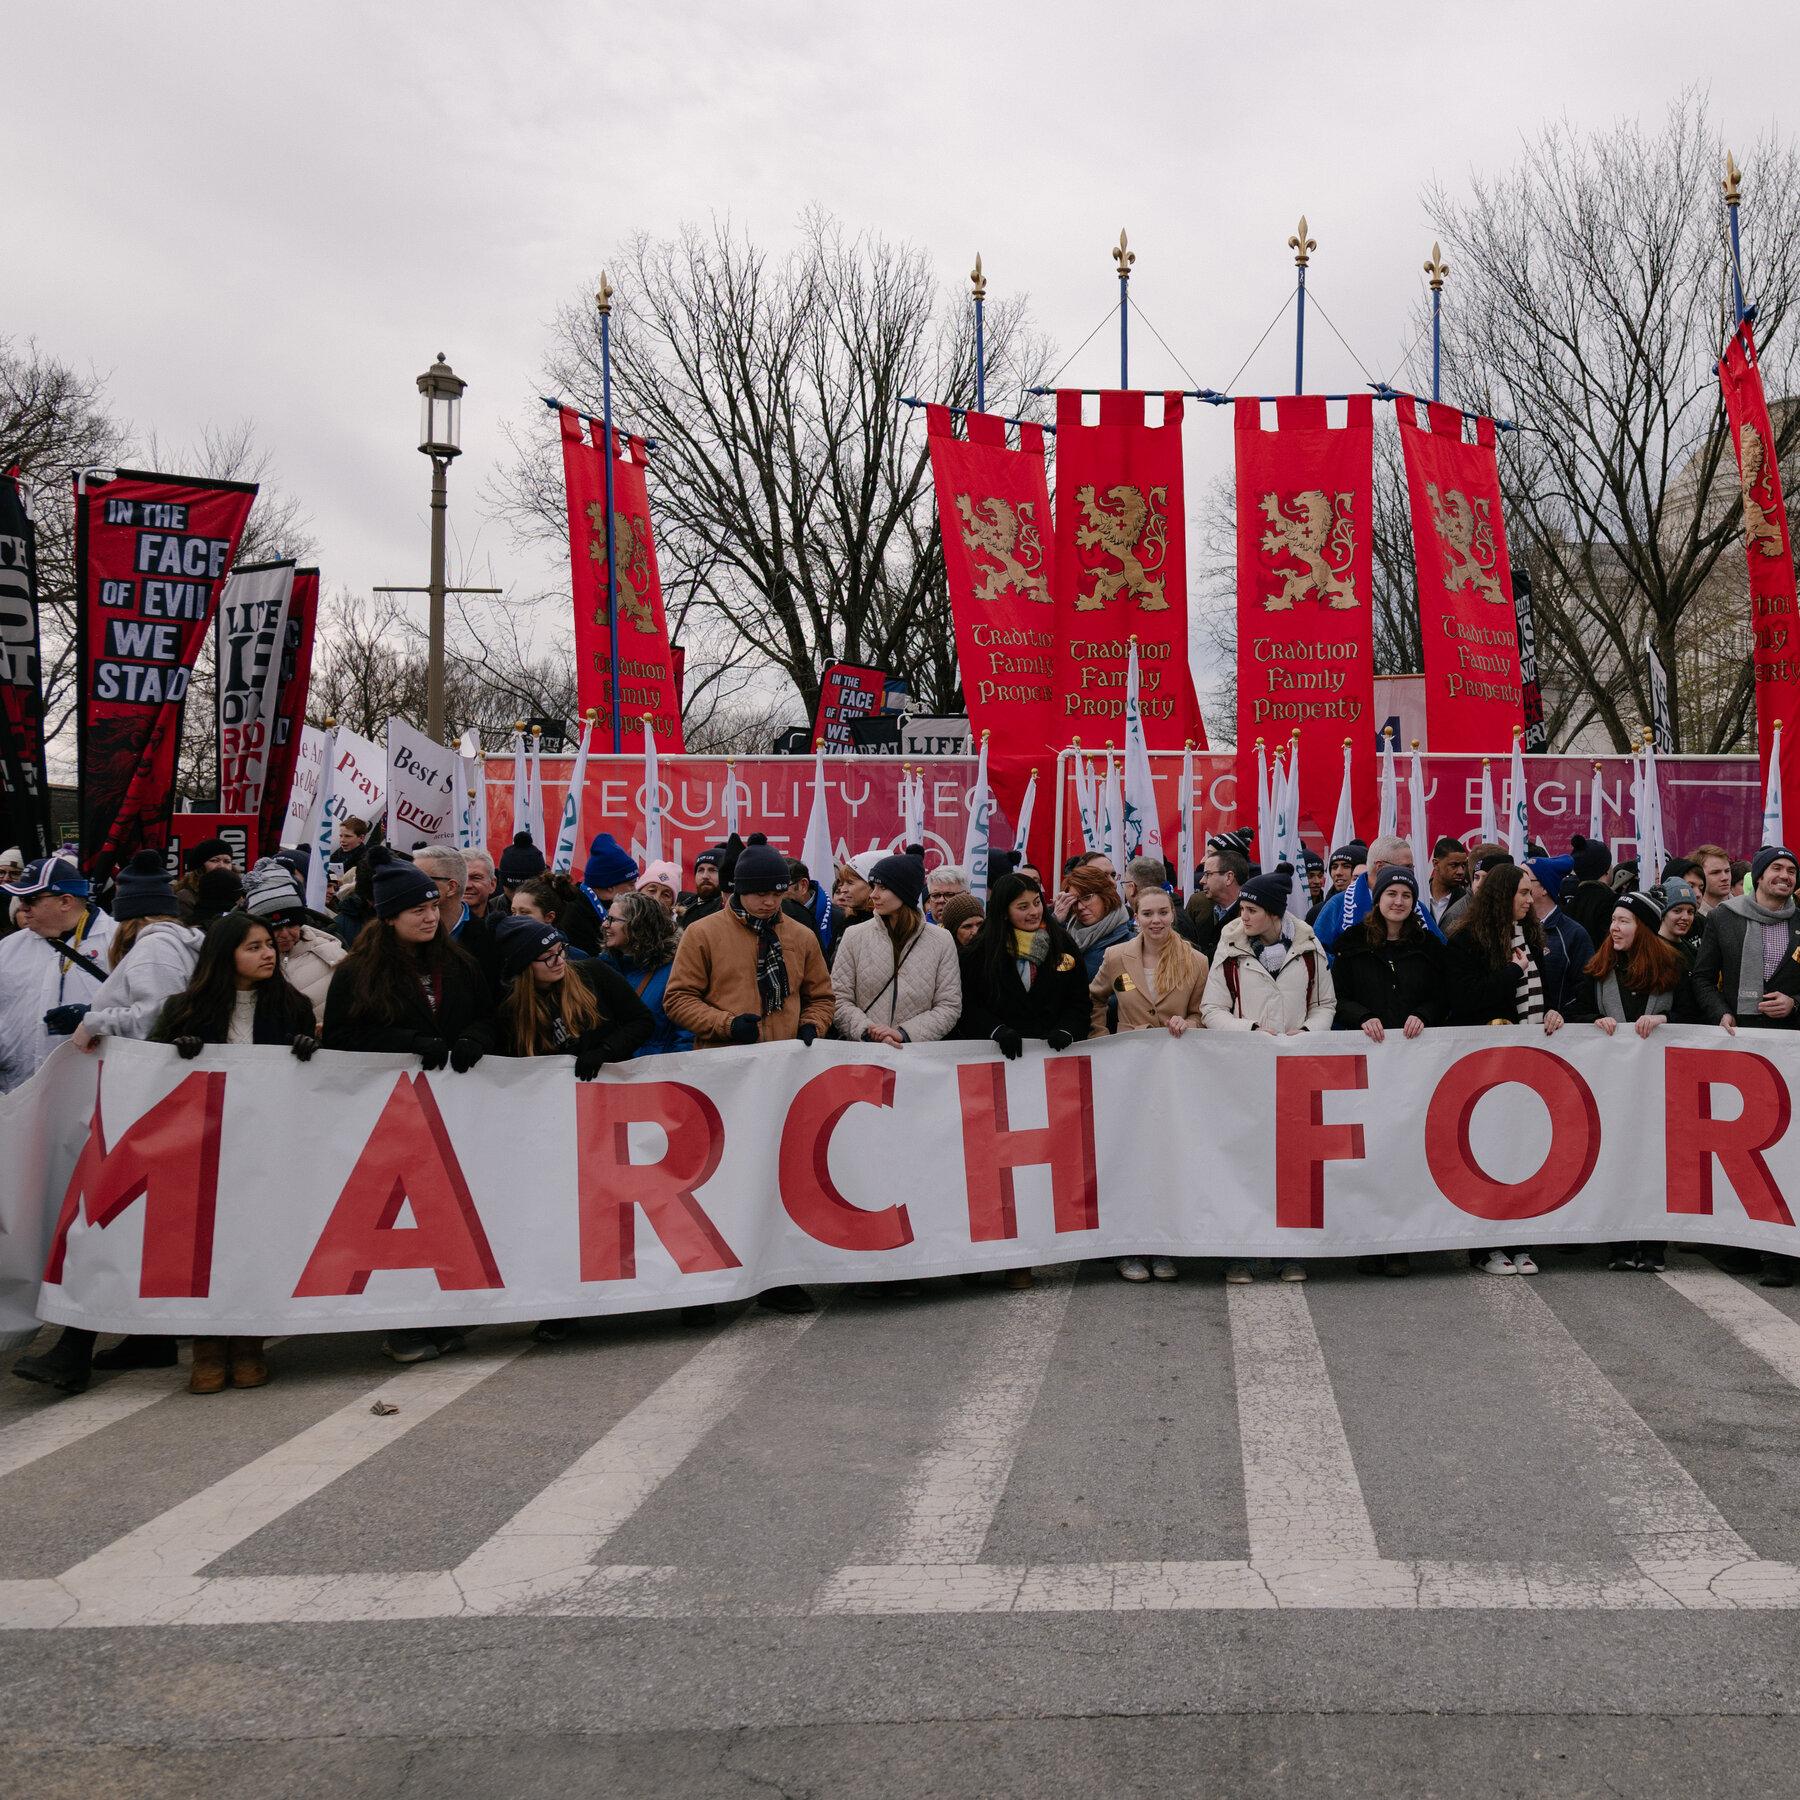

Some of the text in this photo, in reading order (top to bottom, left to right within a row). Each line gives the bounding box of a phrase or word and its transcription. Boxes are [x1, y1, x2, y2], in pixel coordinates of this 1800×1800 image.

[108, 500, 186, 529] IN THE
[138, 533, 230, 578] FACE
[102, 581, 132, 606] OF
[112, 620, 178, 660] WE
[1441, 615, 1515, 647] Tradition
[1069, 640, 1171, 661] Tradiion
[1253, 637, 1358, 662] Tradition
[1457, 645, 1511, 677] Family
[832, 674, 860, 688] IN THE
[1081, 667, 1161, 692] Famly
[1267, 667, 1346, 693] Family
[1447, 673, 1521, 707] Property
[603, 679, 660, 709] Fmily
[840, 688, 874, 709] FACE
[1064, 693, 1176, 720] Proprty
[826, 707, 836, 717] OF
[1253, 698, 1362, 723] Property
[827, 724, 851, 742] WE
[335, 750, 384, 805] Pray
[394, 745, 438, 787] Best
[1248, 892, 1257, 900] LIFE
[44, 1046, 1797, 1299] MARCH FOR
